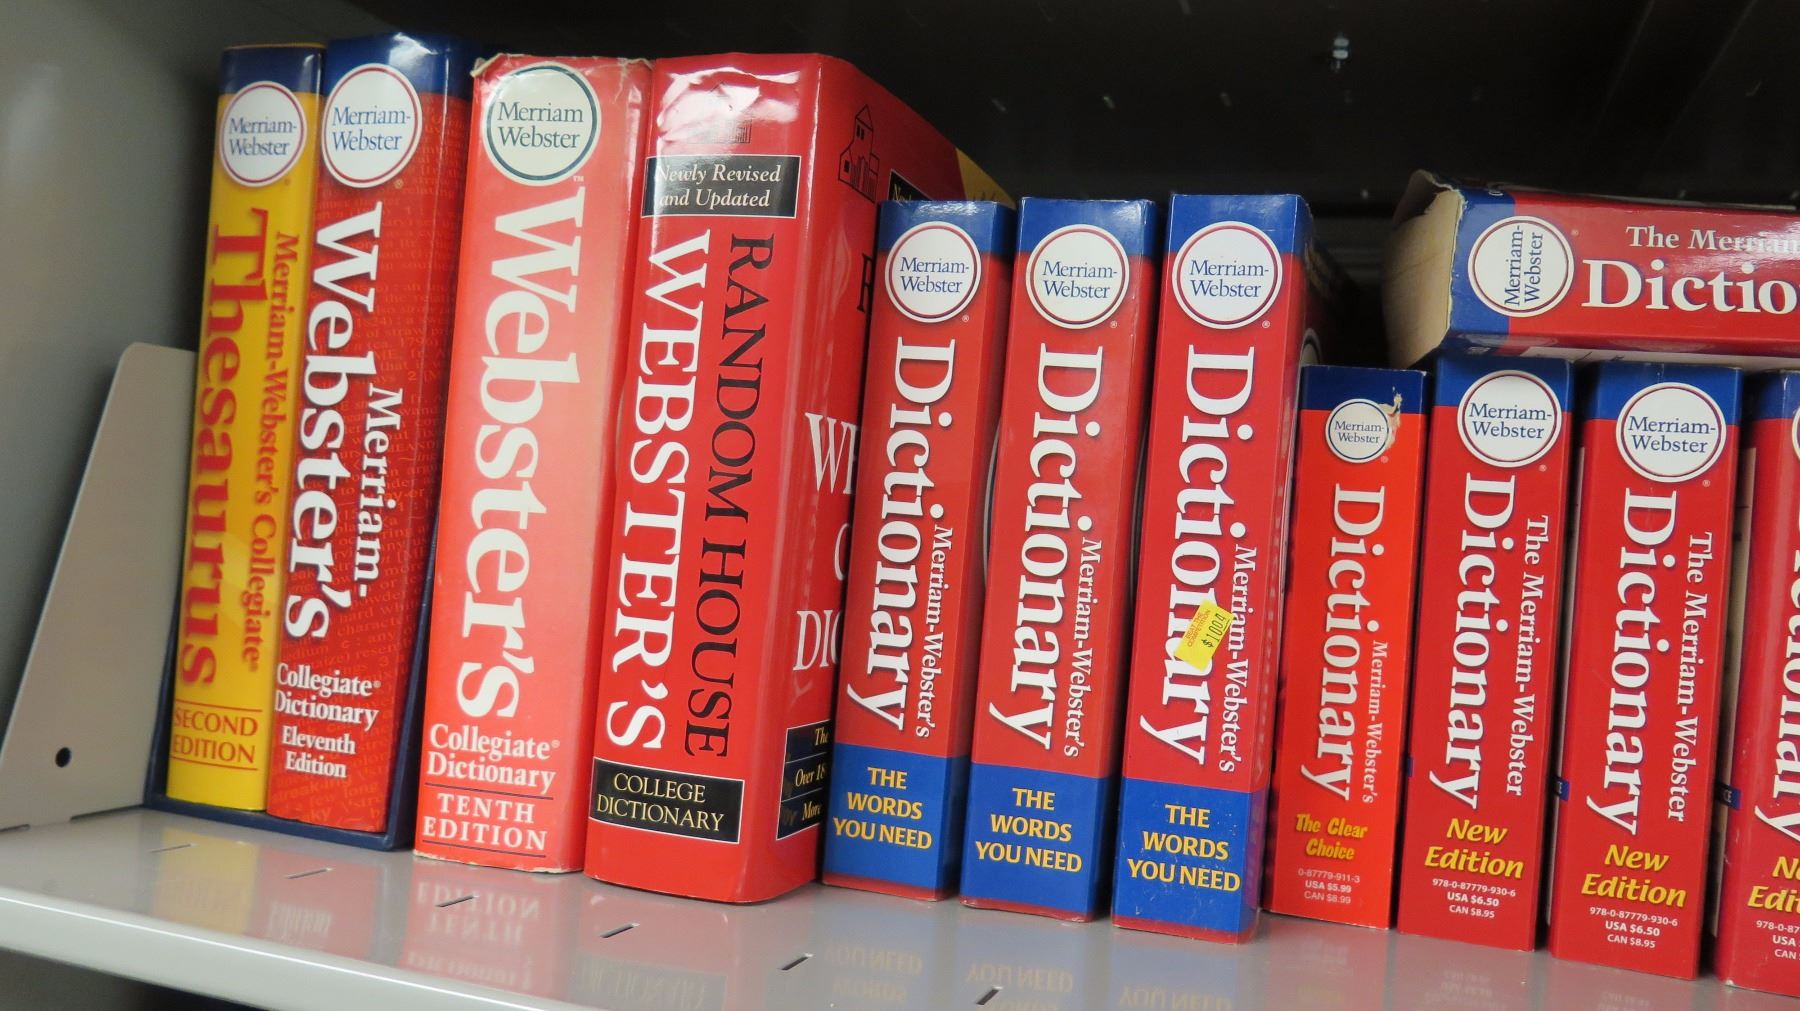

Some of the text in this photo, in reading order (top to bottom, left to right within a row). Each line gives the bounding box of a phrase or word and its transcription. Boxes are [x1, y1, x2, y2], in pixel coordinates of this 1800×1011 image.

[228, 115, 297, 135] Merriam-
[331, 105, 411, 127] Merriam-
[498, 99, 585, 126] Merriam
[228, 136, 291, 156] Webster
[331, 128, 403, 152] Webster
[497, 125, 581, 150] Webster
[655, 163, 782, 185] Newly Revised
[659, 188, 770, 210] and Updated
[1625, 225, 1680, 249] The
[899, 254, 970, 275] Merriam-
[1042, 258, 1118, 279] Merriam-
[1188, 257, 1270, 278] Merriam-
[1503, 225, 1524, 307] Merriam-
[1523, 231, 1544, 303] Webster
[899, 275, 964, 295] Webster
[1043, 279, 1112, 300] Webster
[1189, 277, 1263, 299] Webster
[1582, 259, 1800, 316] Dictio
[255, 231, 300, 506] Merriam-Webster's
[284, 201, 384, 639] Webster's
[1469, 402, 1553, 422] Merriam-
[1627, 415, 1716, 435] Merriam-
[1334, 419, 1385, 435] Merriam-
[1337, 432, 1380, 446] Webster
[1472, 421, 1544, 440] Webster
[181, 207, 270, 686] Thesaurus
[456, 186, 587, 719] Webster's
[1631, 434, 1708, 454] Webster
[353, 387, 404, 599] Merriam-
[605, 228, 711, 751] WEBSTER'S
[684, 233, 776, 758] RANDOM HOUSE
[847, 337, 957, 732] Dictionary
[988, 342, 1105, 751] Dictionary
[915, 524, 954, 738] Merriam-Webster's
[1300, 482, 1386, 802] Dictionary
[1429, 472, 1517, 809] Dictionary
[1063, 536, 1103, 759] Merriam-Webster's
[1217, 543, 1258, 774] Merriam-Webster's
[1505, 514, 1549, 797] The Merriam-Webster
[1586, 487, 1679, 836] Dictionary
[1667, 531, 1713, 823] The Merriam-Webster
[174, 706, 259, 737] SECOND
[274, 689, 380, 732] Dictionary
[1361, 639, 1389, 805] Merriam-Webster's
[171, 733, 257, 764] EDITION
[281, 725, 356, 755] Eleventh
[285, 750, 347, 779] Edition
[426, 751, 557, 795] Dictionary
[867, 765, 908, 790] THE
[613, 772, 706, 804] COLLEGE
[1012, 787, 1056, 811] THE
[437, 792, 536, 824] TENTH
[596, 793, 725, 832] DICTIONARY
[846, 790, 923, 820] WORDS
[1164, 803, 1211, 829] THE
[422, 816, 548, 851] EDITION
[832, 815, 932, 850] YOU NEED
[990, 813, 1073, 842] WORDS
[1295, 813, 1369, 839] The Clear
[1446, 818, 1508, 844] New
[975, 841, 1083, 874] YOU NEED
[1142, 832, 1230, 861] WORDS
[1305, 838, 1355, 860] Choice
[1604, 844, 1670, 872] New
[1127, 859, 1242, 893] YOU NEED
[1424, 846, 1525, 879] Edition
[1303, 890, 1325, 901] CAN
[1305, 880, 1326, 890] USA
[1432, 878, 1516, 897] 978-0-87779-930-6
[1447, 891, 1500, 907] USA $6.50
[1581, 873, 1687, 908] Edition
[1449, 904, 1495, 919] CAN $8.95
[1589, 906, 1678, 927] 978-0-87779-930-6
[1605, 920, 1660, 937] USA $6.50
[1607, 934, 1656, 949] CAN $8.95
[1772, 935, 1797, 947] USA
[1774, 949, 1797, 960] CAN
